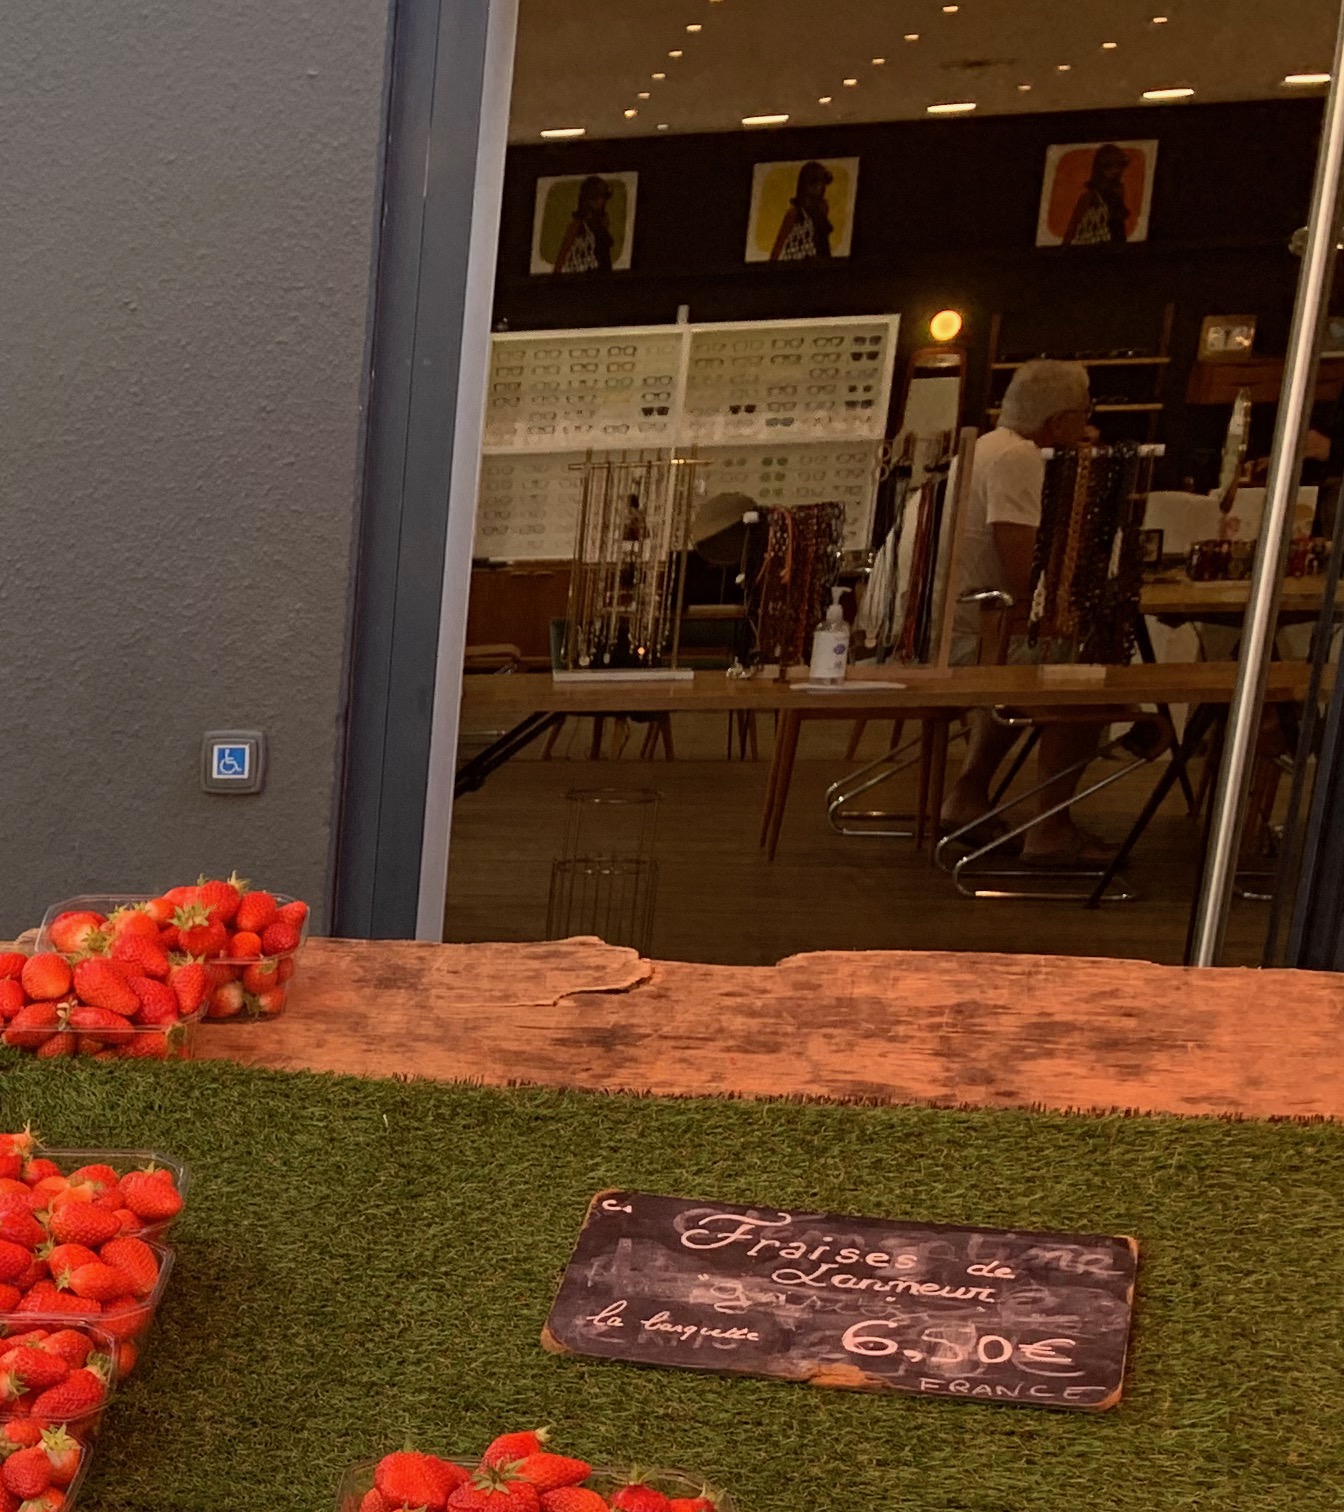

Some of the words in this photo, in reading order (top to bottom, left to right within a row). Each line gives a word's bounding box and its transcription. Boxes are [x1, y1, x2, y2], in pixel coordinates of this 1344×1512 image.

[680, 1212, 918, 1269] Fraises
[967, 1260, 1016, 1279] de
[919, 1377, 1107, 1400] FRANCE
